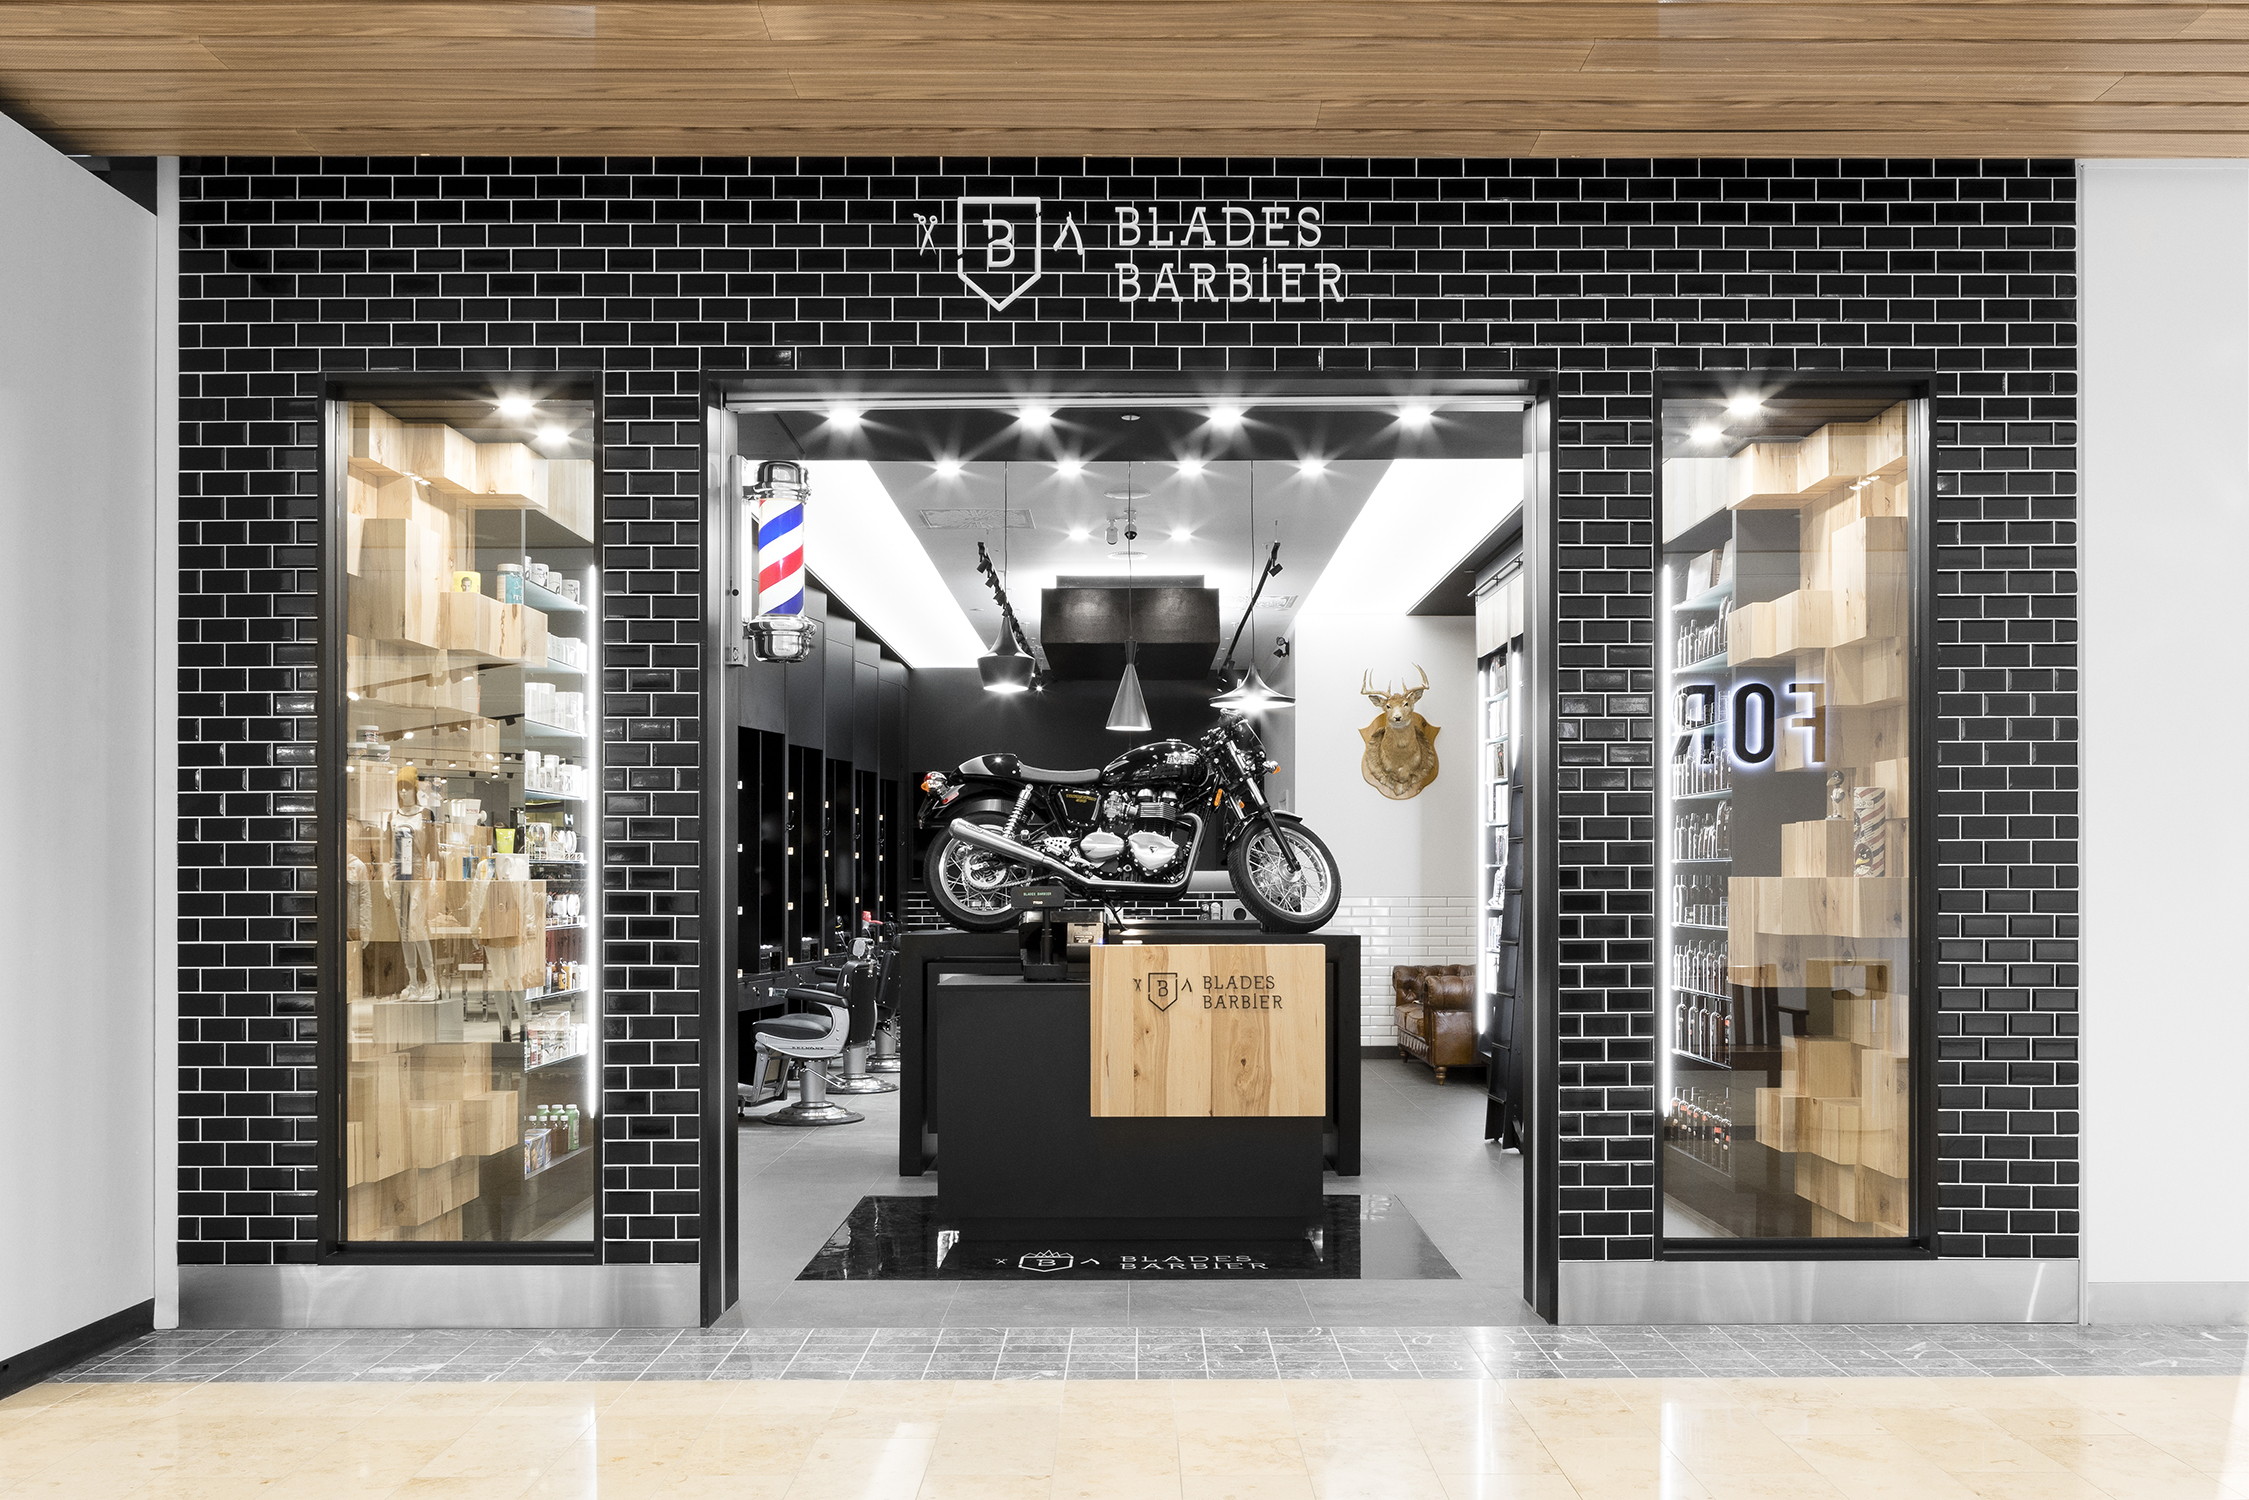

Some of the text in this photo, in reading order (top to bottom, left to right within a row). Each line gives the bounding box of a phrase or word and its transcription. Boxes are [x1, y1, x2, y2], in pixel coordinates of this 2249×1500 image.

[1114, 206, 1322, 247] BLADES
[982, 218, 1015, 268] B
[1114, 256, 1345, 303] BARBIER
[1156, 979, 1169, 997] B
[1202, 975, 1276, 990] BLADES
[1202, 993, 1283, 1010] BARBIER
[1036, 1258, 1056, 1267] B
[1119, 1255, 1252, 1263] BLADES
[1119, 1262, 1269, 1270] BARBIER
